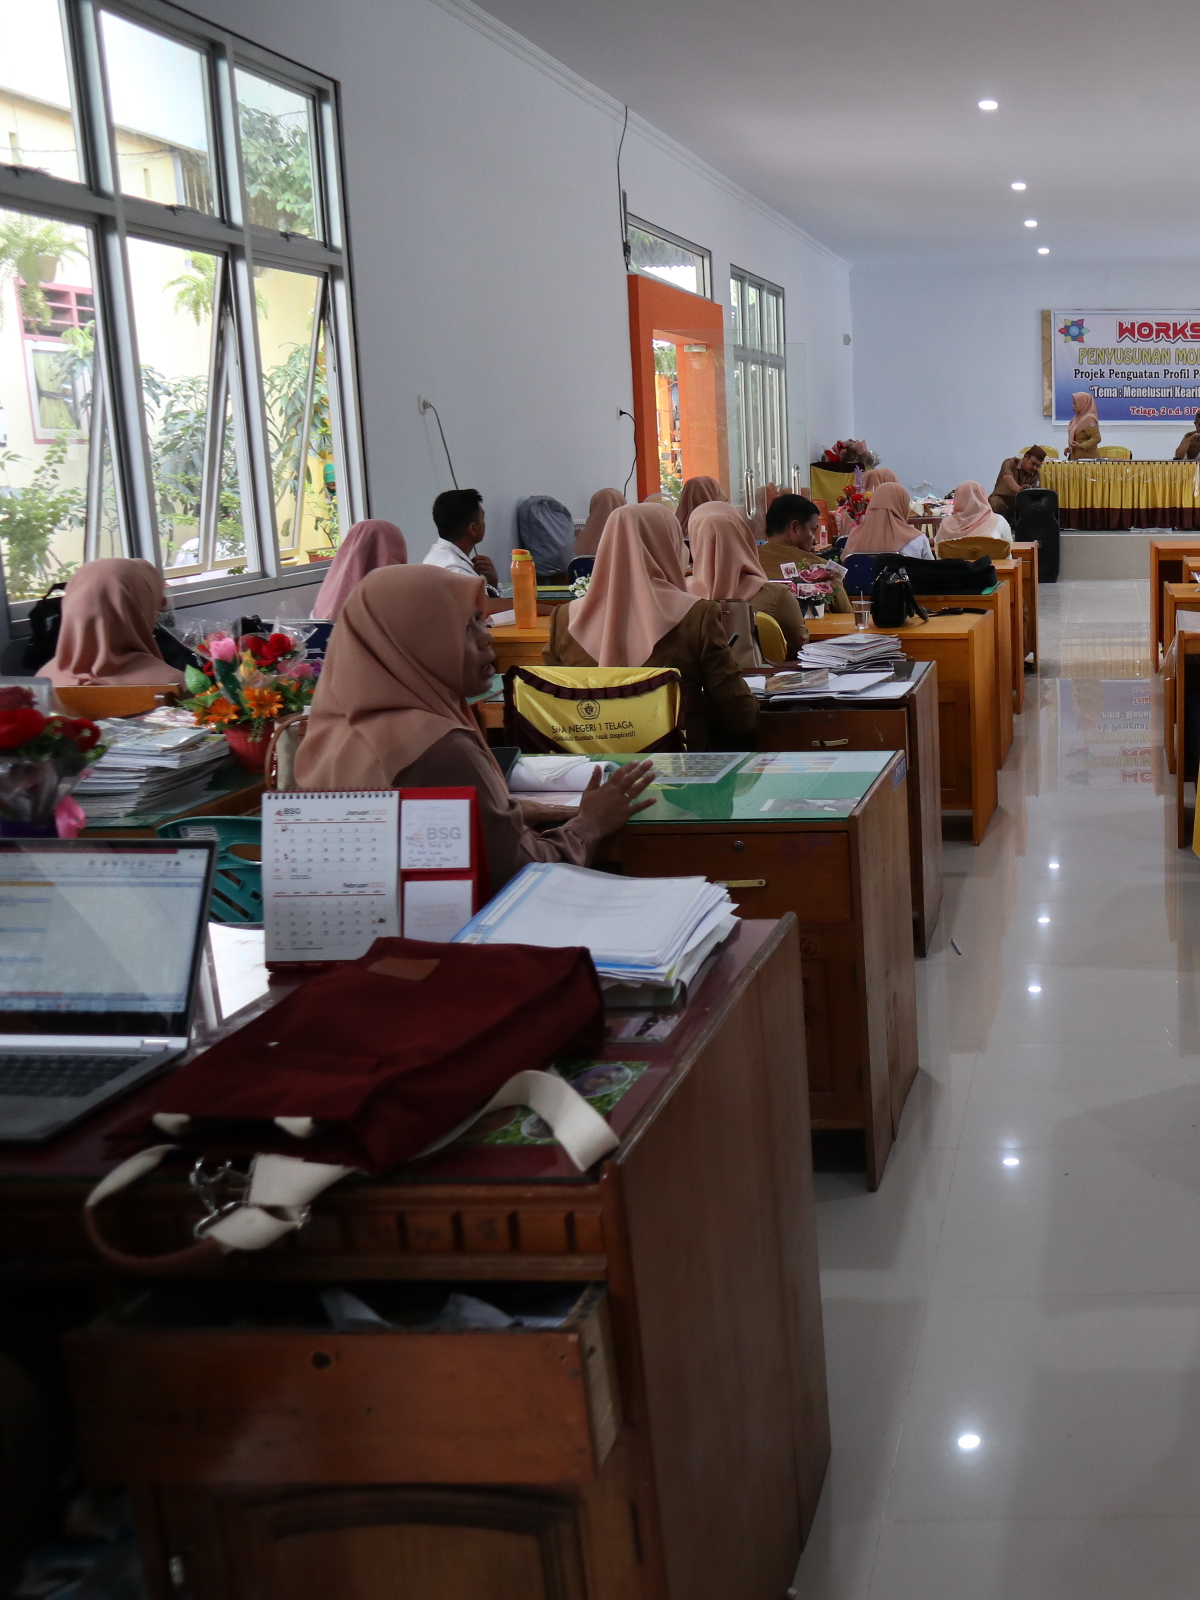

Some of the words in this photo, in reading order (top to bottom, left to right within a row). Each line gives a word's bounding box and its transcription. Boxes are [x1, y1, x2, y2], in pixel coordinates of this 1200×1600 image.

[1078, 347, 1171, 365] PENYUSUNAN
[1073, 368, 1106, 381] Projek
[1108, 368, 1160, 381] Penguatan
[1163, 368, 1190, 379] Profil
[1123, 385, 1173, 398] Menelusuri
[1130, 406, 1159, 417] Telaga,
[1160, 407, 1166, 415] 2
[1184, 407, 1190, 415] 3
[568, 723, 596, 733] NEGERI
[604, 720, 634, 731] TELAGA
[426, 827, 461, 840] BSG
